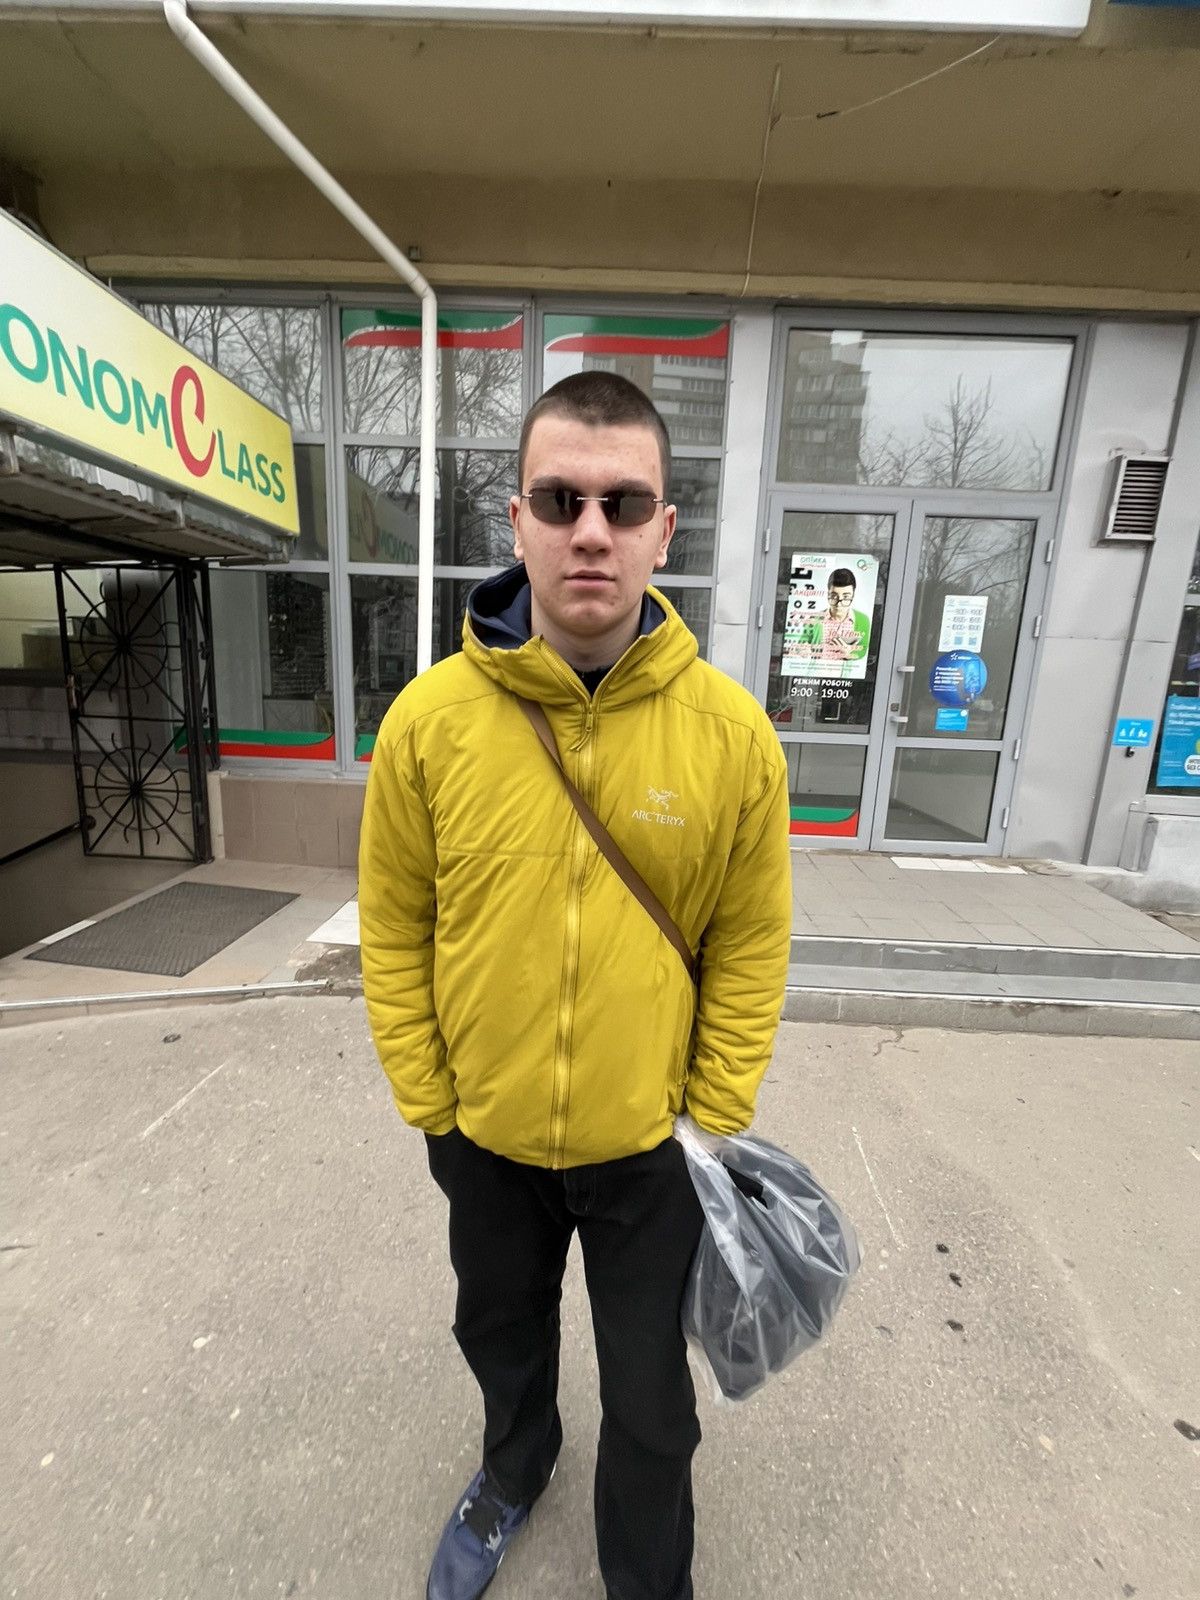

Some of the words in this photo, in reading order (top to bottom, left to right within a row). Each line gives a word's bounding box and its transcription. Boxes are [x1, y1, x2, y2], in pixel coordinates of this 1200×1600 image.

[793, 678, 820, 686] РЕЖИМ
[790, 687, 813, 697] 9:00
[821, 688, 849, 699] 19:00
